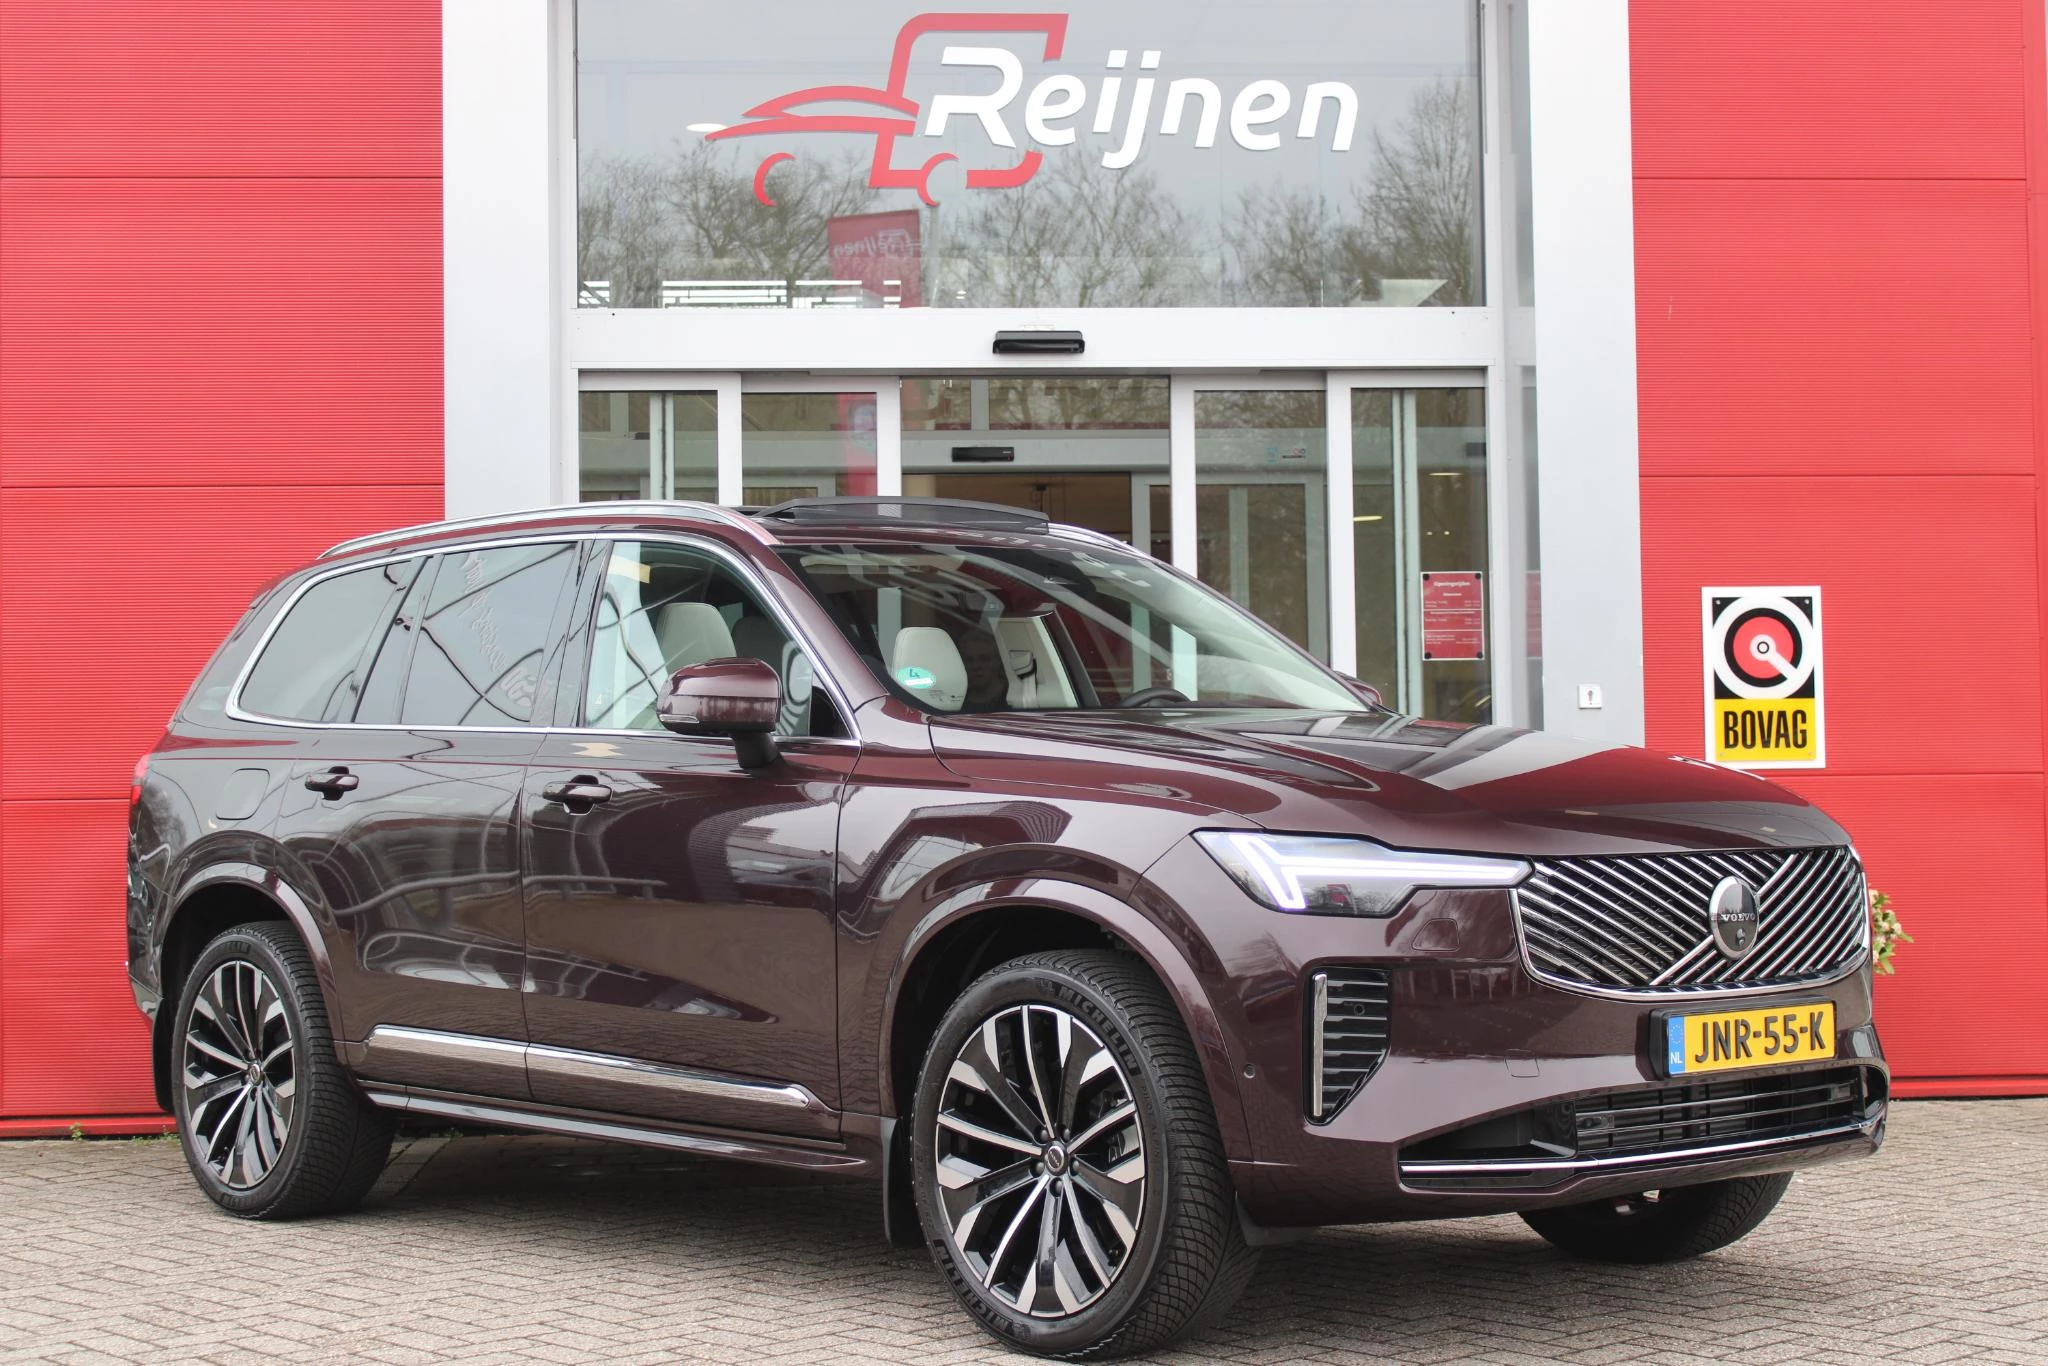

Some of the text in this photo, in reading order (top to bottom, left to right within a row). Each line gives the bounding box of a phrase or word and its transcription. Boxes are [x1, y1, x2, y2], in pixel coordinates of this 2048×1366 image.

[924, 46, 1359, 169] Reijnen
[1723, 709, 1808, 749] BOVAG
[1721, 912, 1756, 922] VOLVO
[1059, 984, 1140, 1075] MICHELIN
[1695, 1011, 1826, 1063] JNR-55-K
[1670, 1052, 1683, 1065] NL
